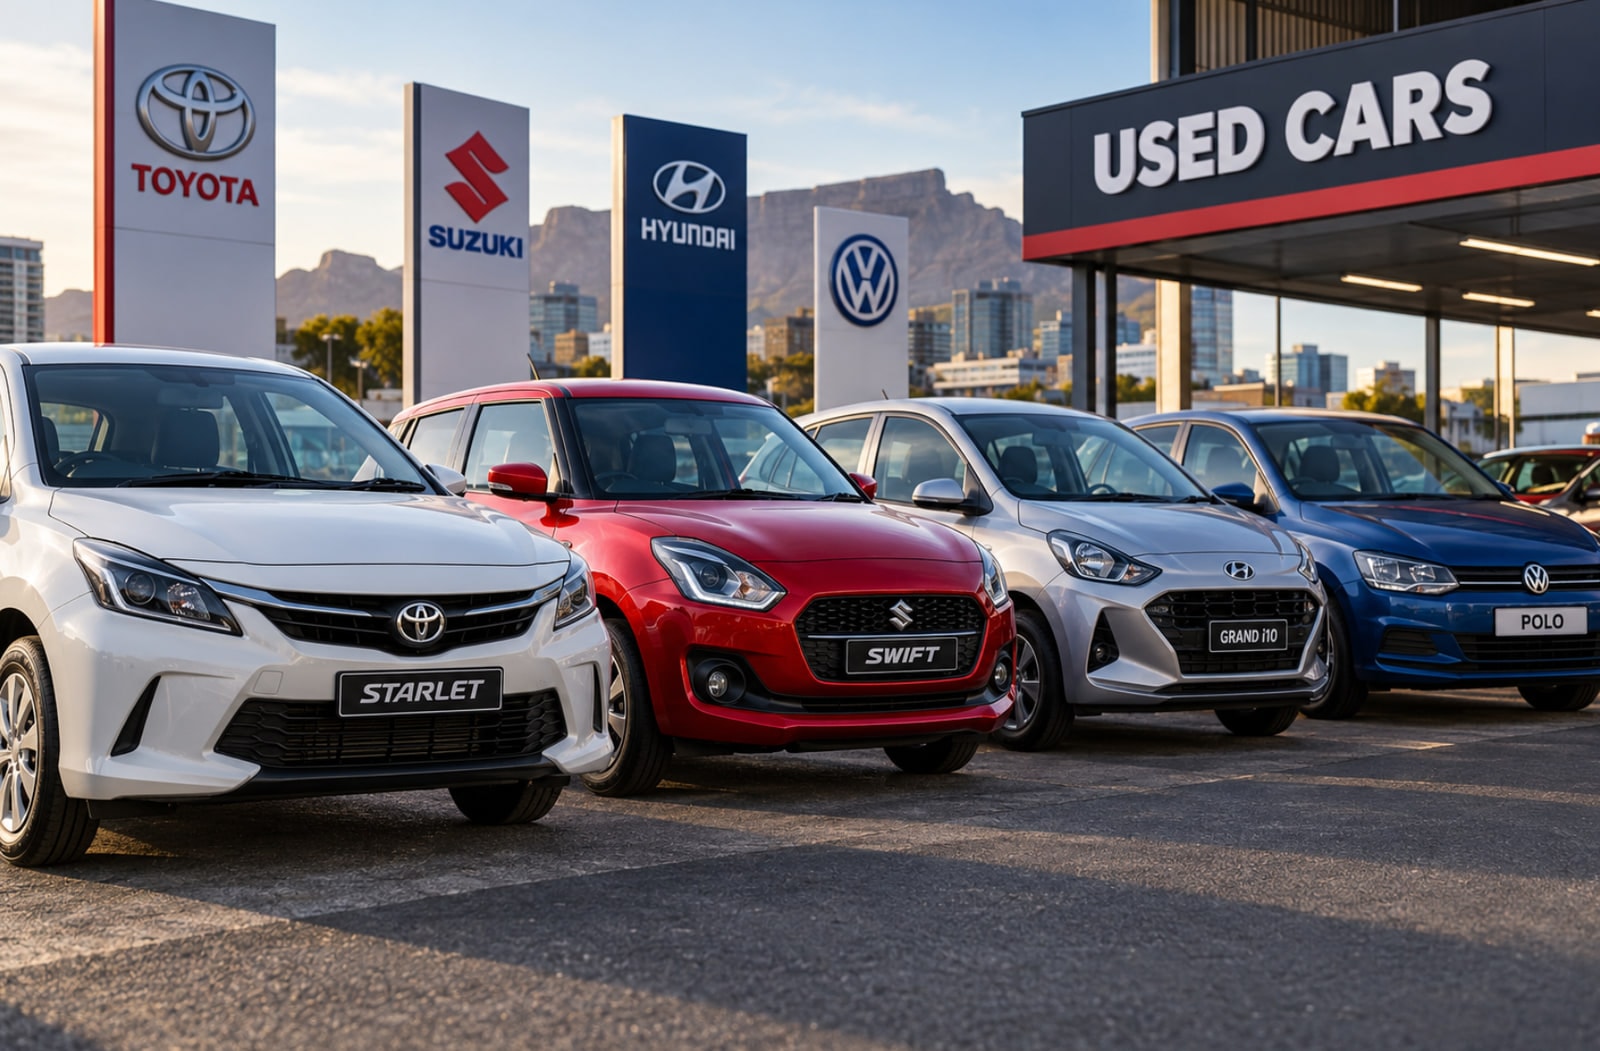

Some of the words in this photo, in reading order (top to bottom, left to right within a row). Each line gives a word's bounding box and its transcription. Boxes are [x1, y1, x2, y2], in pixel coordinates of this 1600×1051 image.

[1093, 105, 1266, 195] USED
[1285, 59, 1492, 162] CARS
[131, 163, 259, 207] TOYOTA
[428, 225, 523, 259] SUZUKI
[641, 217, 735, 250] HYUNDAI
[834, 239, 895, 321] VW
[1525, 564, 1549, 594] VW
[1220, 629, 1259, 644] GRAND
[1262, 628, 1278, 643] i10
[1521, 613, 1564, 631] POLO
[865, 645, 940, 665] SWIFT
[359, 679, 486, 705] STARLET
